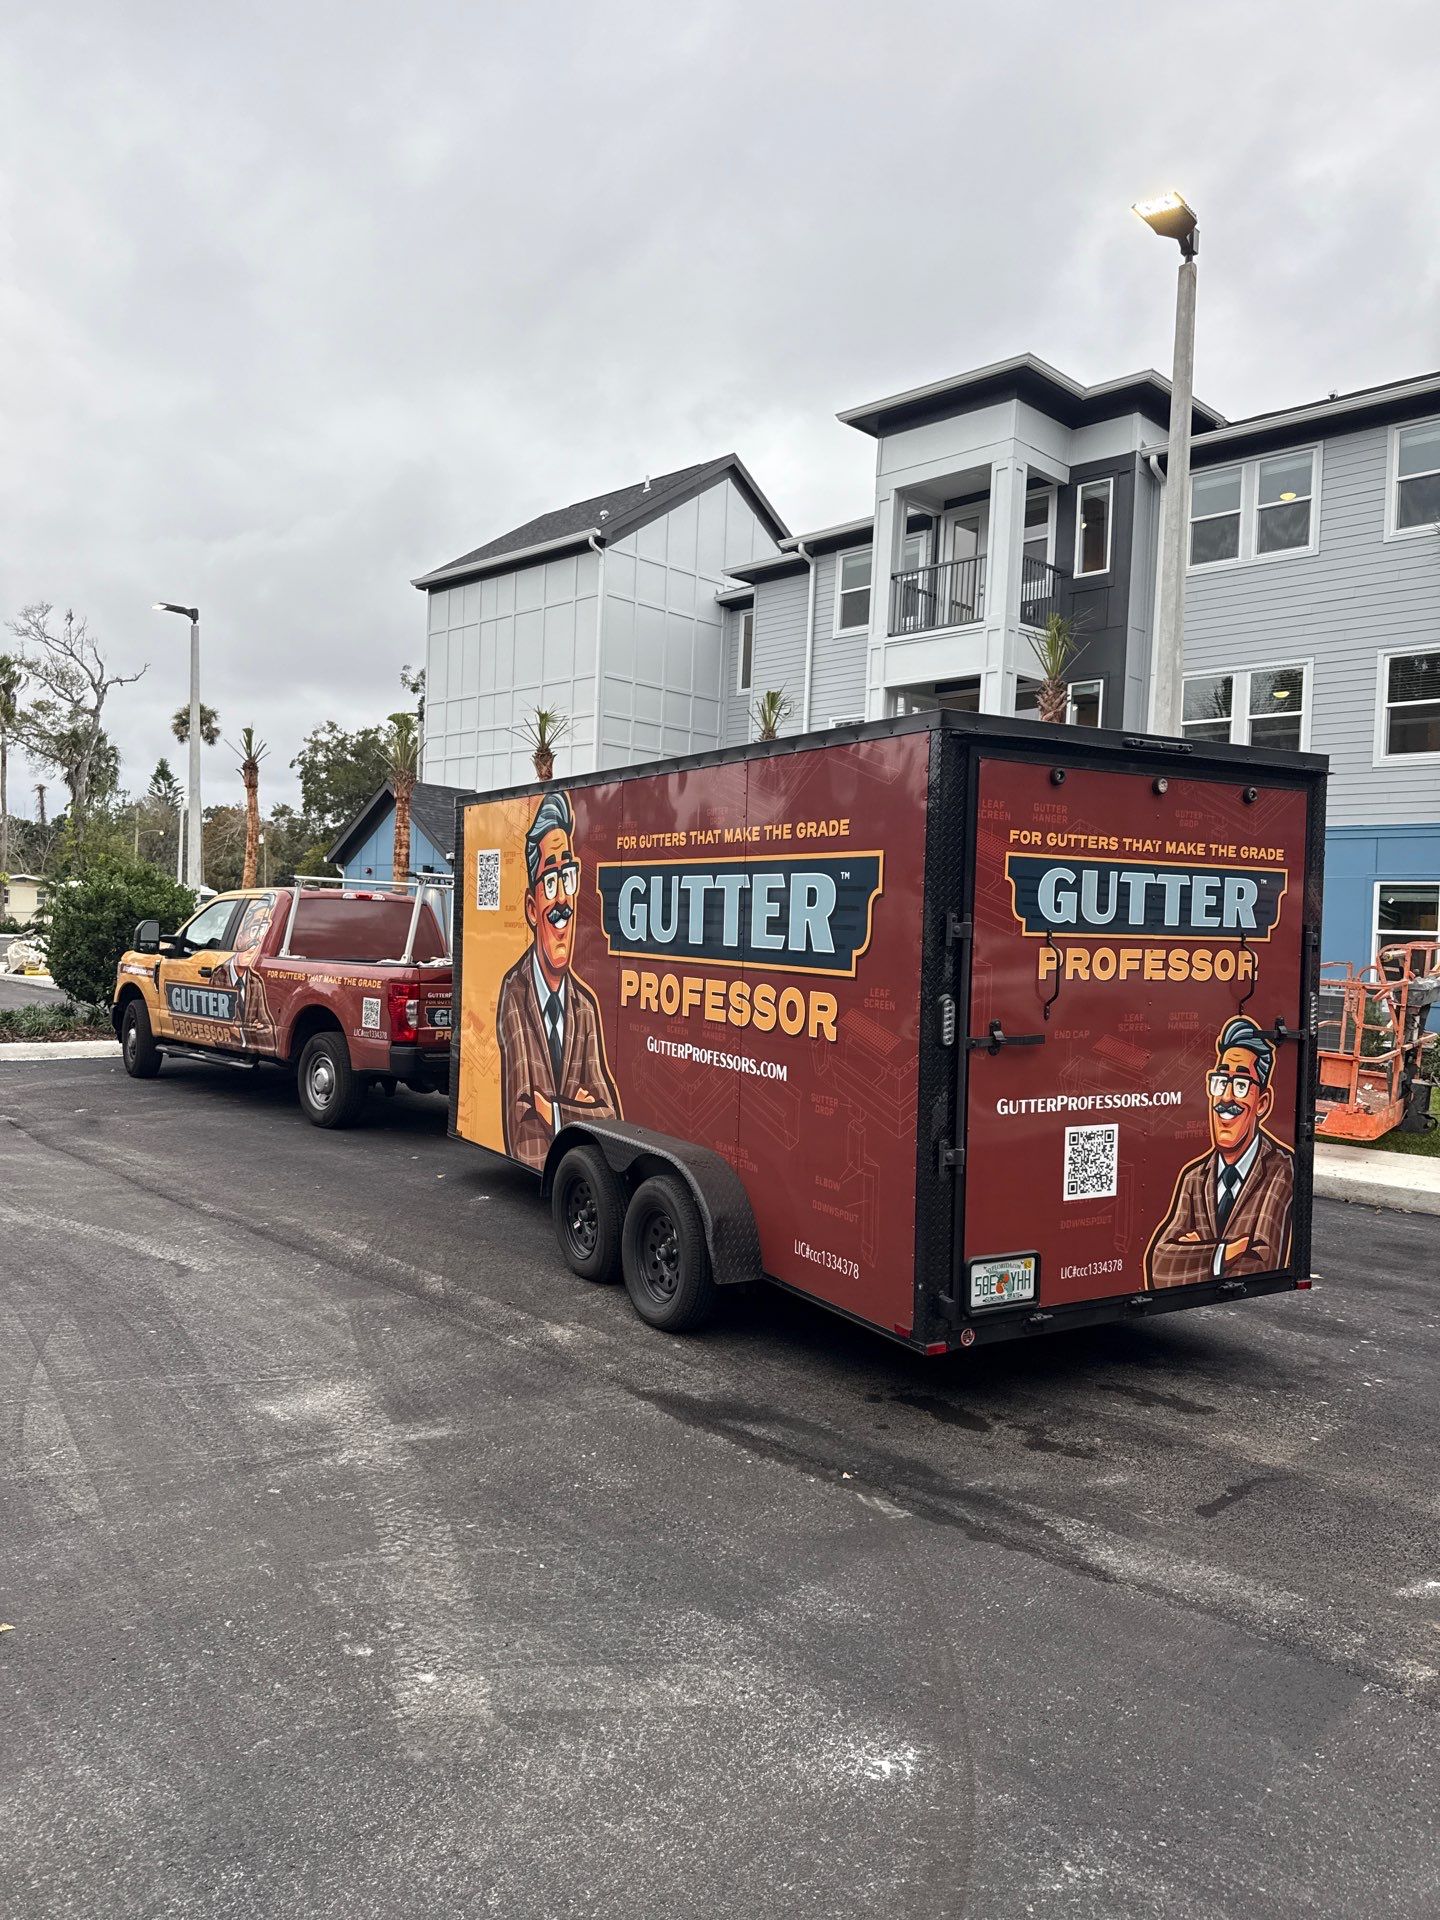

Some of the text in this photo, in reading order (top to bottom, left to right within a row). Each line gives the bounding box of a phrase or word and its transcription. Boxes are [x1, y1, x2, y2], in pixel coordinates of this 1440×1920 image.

[617, 835, 637, 850] FOR
[639, 831, 687, 849] GUTTERS
[690, 829, 722, 846] THAT
[724, 826, 761, 843] MAKE
[764, 823, 792, 840] THE
[796, 818, 850, 838] GRADE
[1009, 829, 1285, 862] FOR GUTTERS THAT MAKE THE GRADE
[1038, 867, 1258, 929] GUTTER
[618, 872, 837, 954] GUTTER
[1038, 947, 1258, 982] PROFESSOR
[267, 970, 382, 989] FOR GUTTERS THAT MAKE THE GRADE
[869, 988, 890, 998] LEAF
[172, 988, 230, 1018] GUTTER
[620, 969, 838, 1042] PROFESSOR
[864, 998, 896, 1010] SCREEN
[173, 1020, 232, 1042] PROFESSOR
[1054, 1029, 1090, 1040] END CAP
[815, 1175, 841, 1192] ELBOW
[812, 1200, 860, 1224] DOWNSPOUT
[794, 1239, 860, 1280] LIC#ccc1334378
[1060, 1258, 1123, 1280] LIC#ccc1334378
